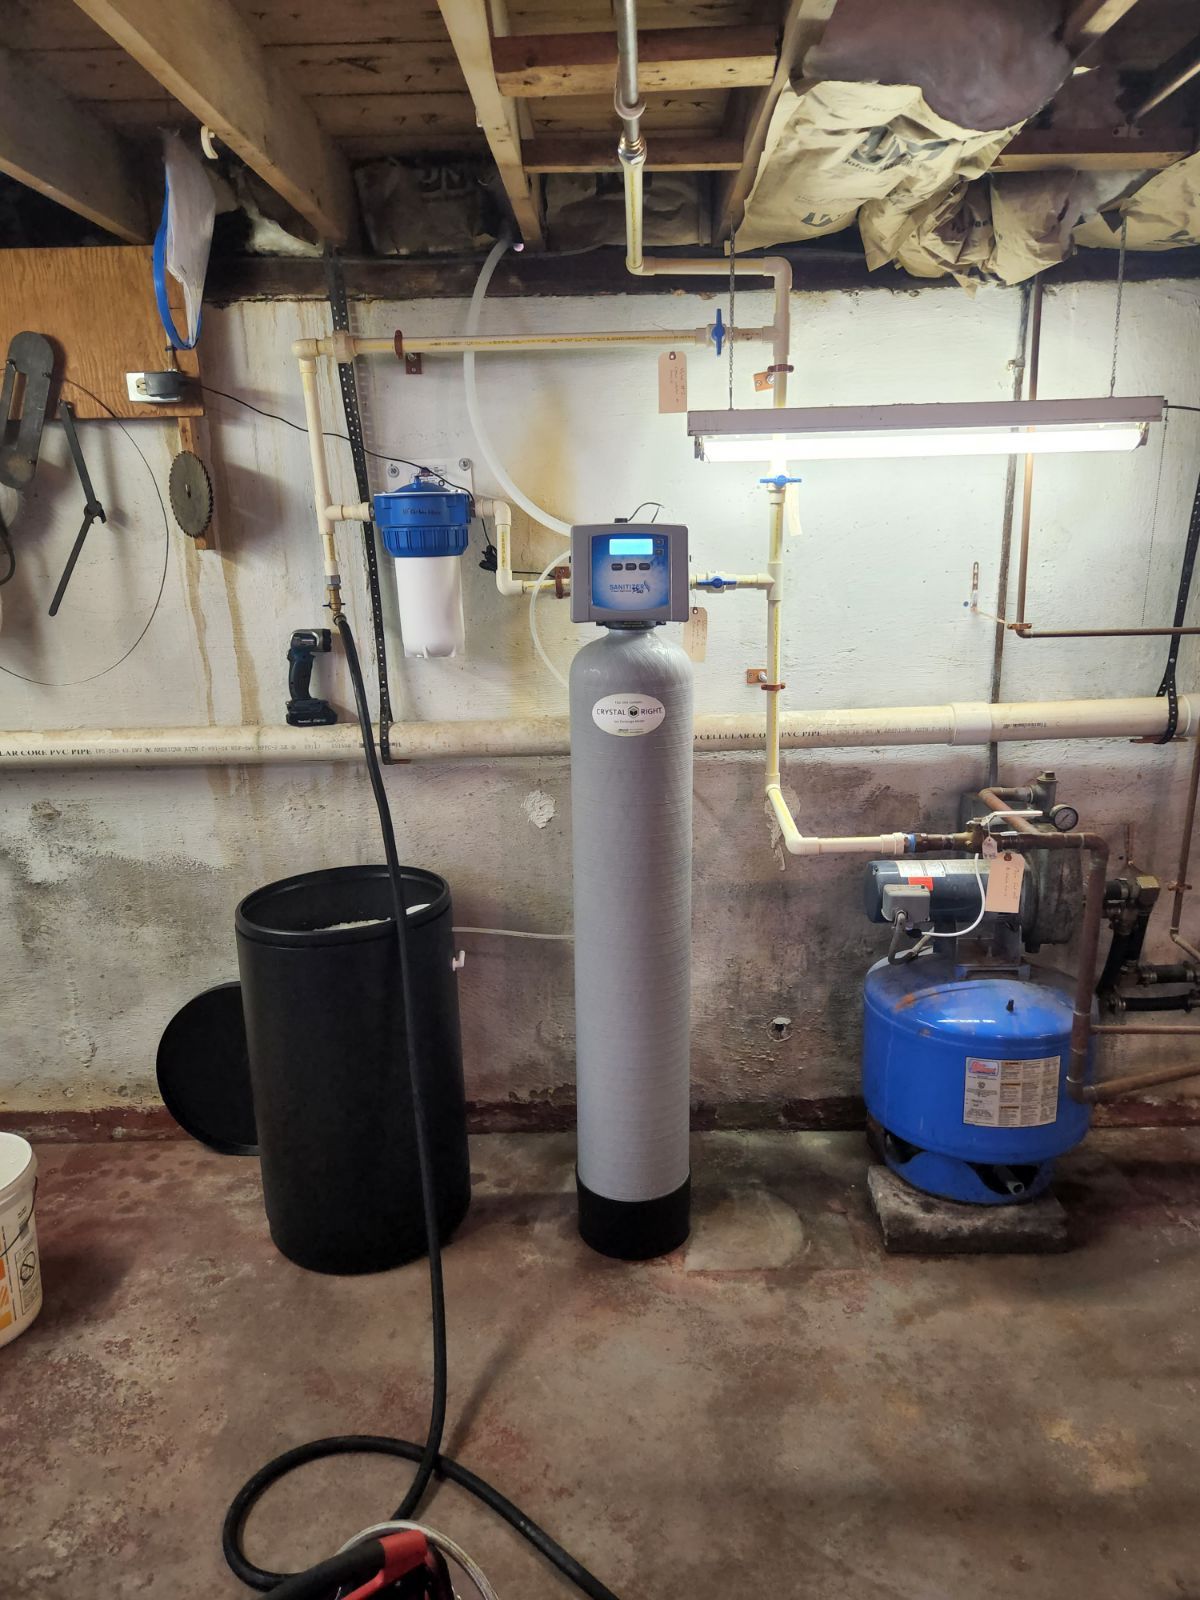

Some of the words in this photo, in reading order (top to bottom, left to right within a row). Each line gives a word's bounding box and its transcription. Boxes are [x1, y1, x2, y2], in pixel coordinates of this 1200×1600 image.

[597, 708, 626, 716] CRYSTAL
[641, 707, 662, 716] RIGHT
[71, 748, 92, 756] PIPE
